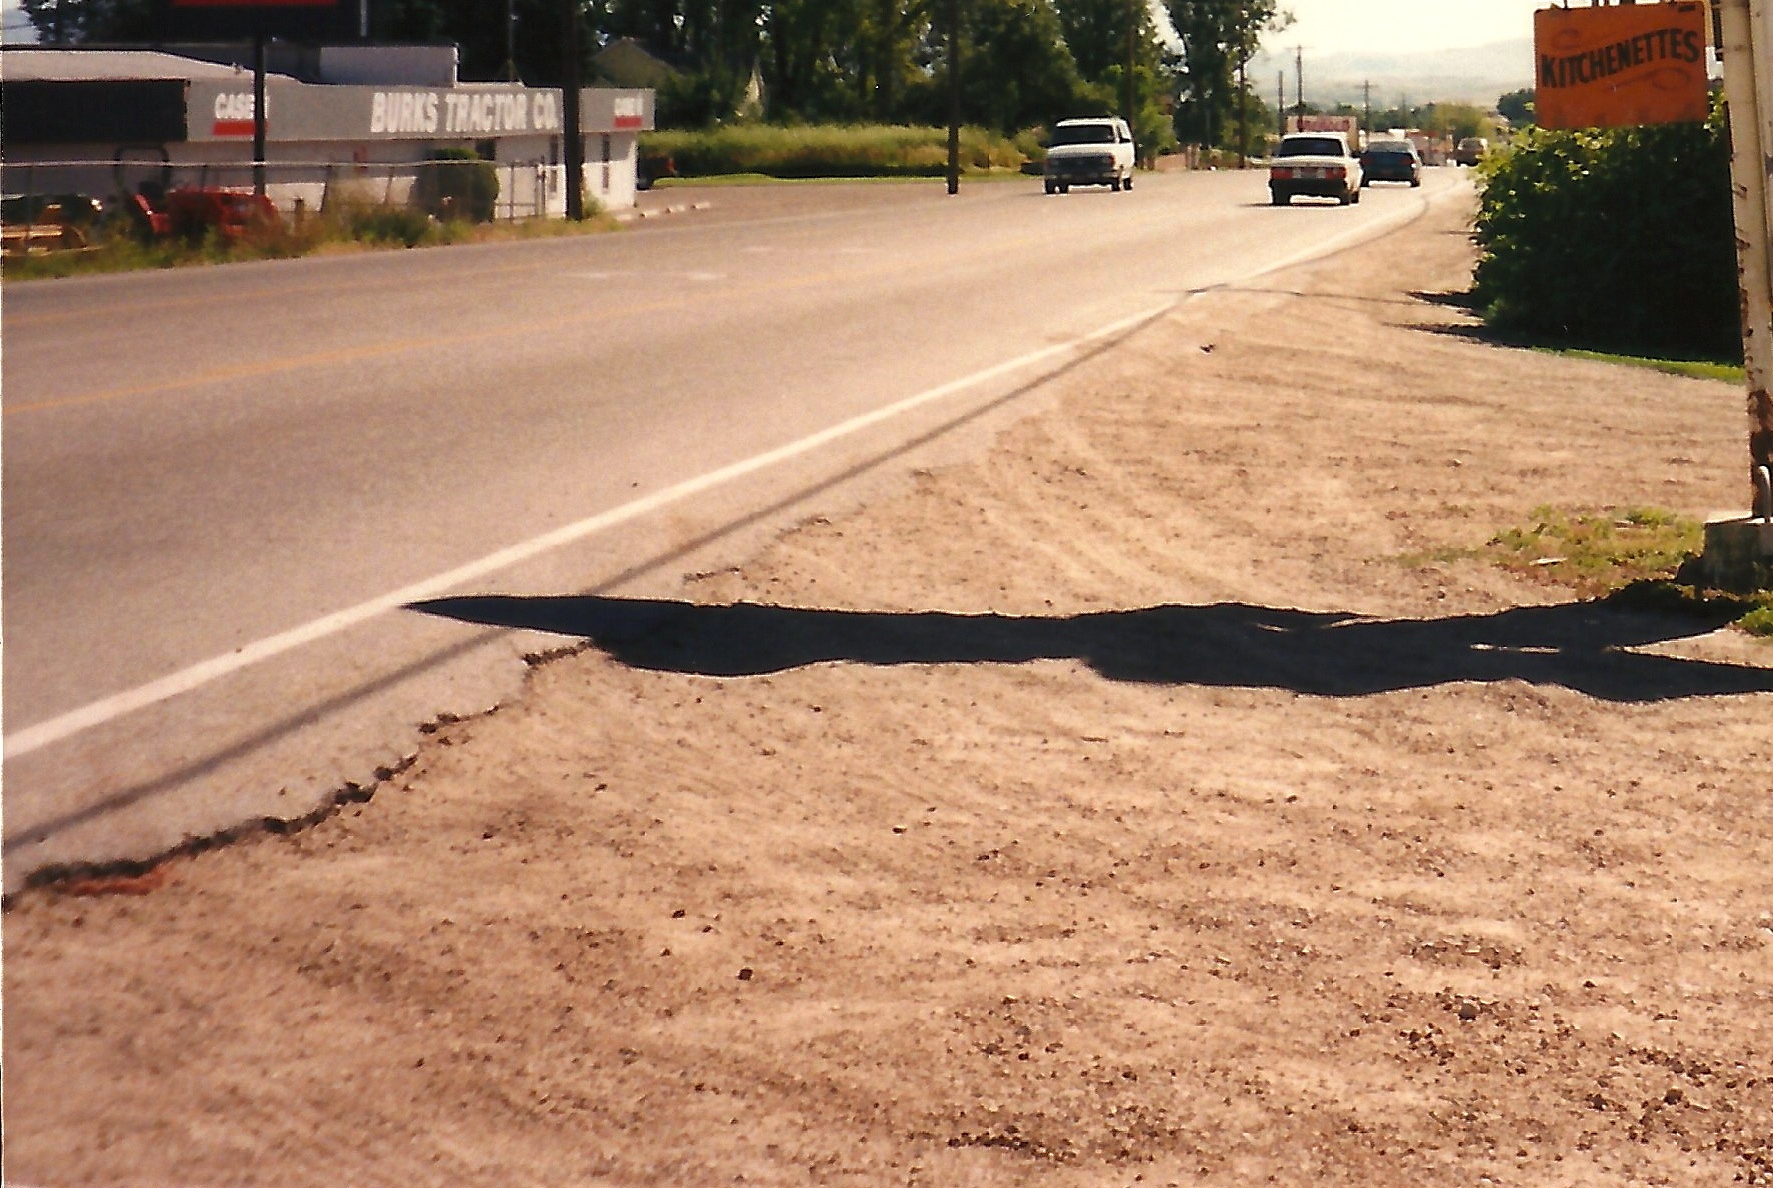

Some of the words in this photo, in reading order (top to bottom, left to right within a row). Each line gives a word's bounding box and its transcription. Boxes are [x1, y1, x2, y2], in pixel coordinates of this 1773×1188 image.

[1541, 27, 1700, 89] KITCHENETTES
[370, 92, 439, 133] BURKS
[445, 92, 528, 132] TRACTOR
